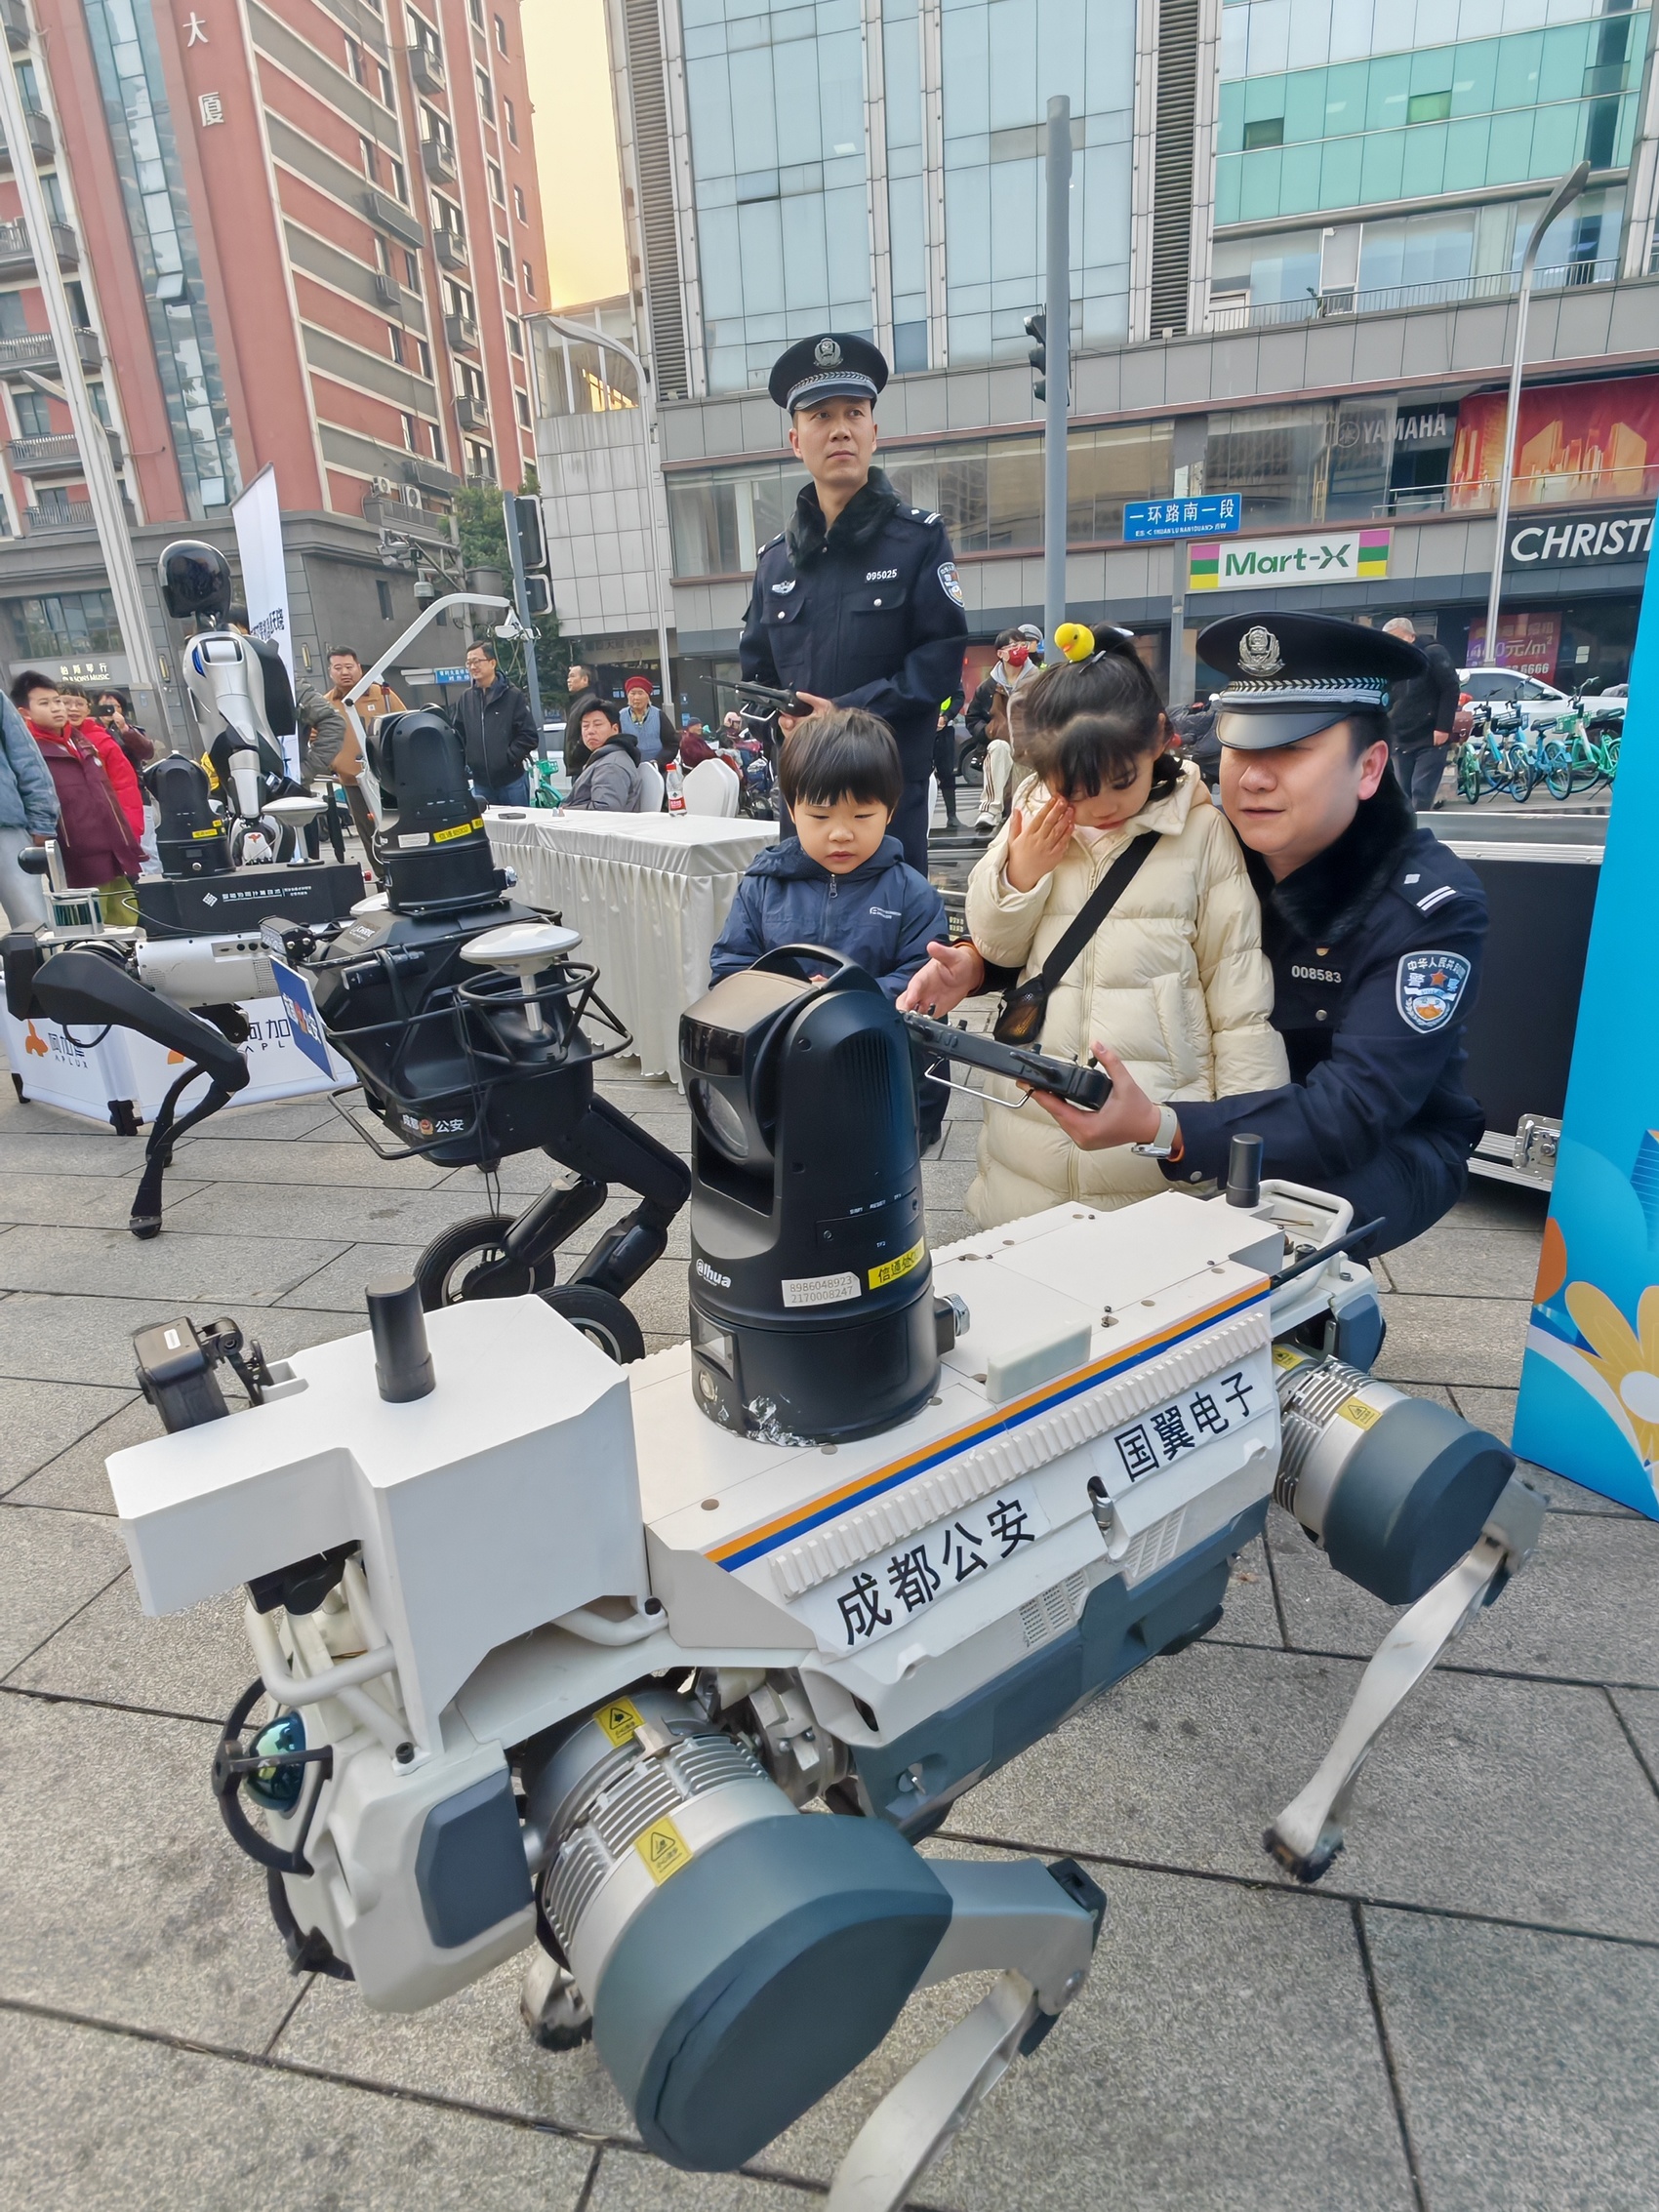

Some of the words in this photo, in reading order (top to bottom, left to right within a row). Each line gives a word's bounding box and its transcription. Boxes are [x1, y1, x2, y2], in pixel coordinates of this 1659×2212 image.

[182, 12, 224, 127] 大厦
[1362, 413, 1446, 444] YAMAHA
[1129, 499, 1234, 525] 一环路南一段
[1225, 543, 1352, 577] Mart-X
[866, 569, 898, 582] 095025
[1291, 965, 1342, 984] 008583
[435, 1118, 465, 1133] 公安
[789, 1275, 853, 1293] 8986048923
[791, 1286, 853, 1304] 2170008247
[1113, 1372, 1253, 1482] 国翼电子
[836, 1500, 1035, 1646] 成都公安
